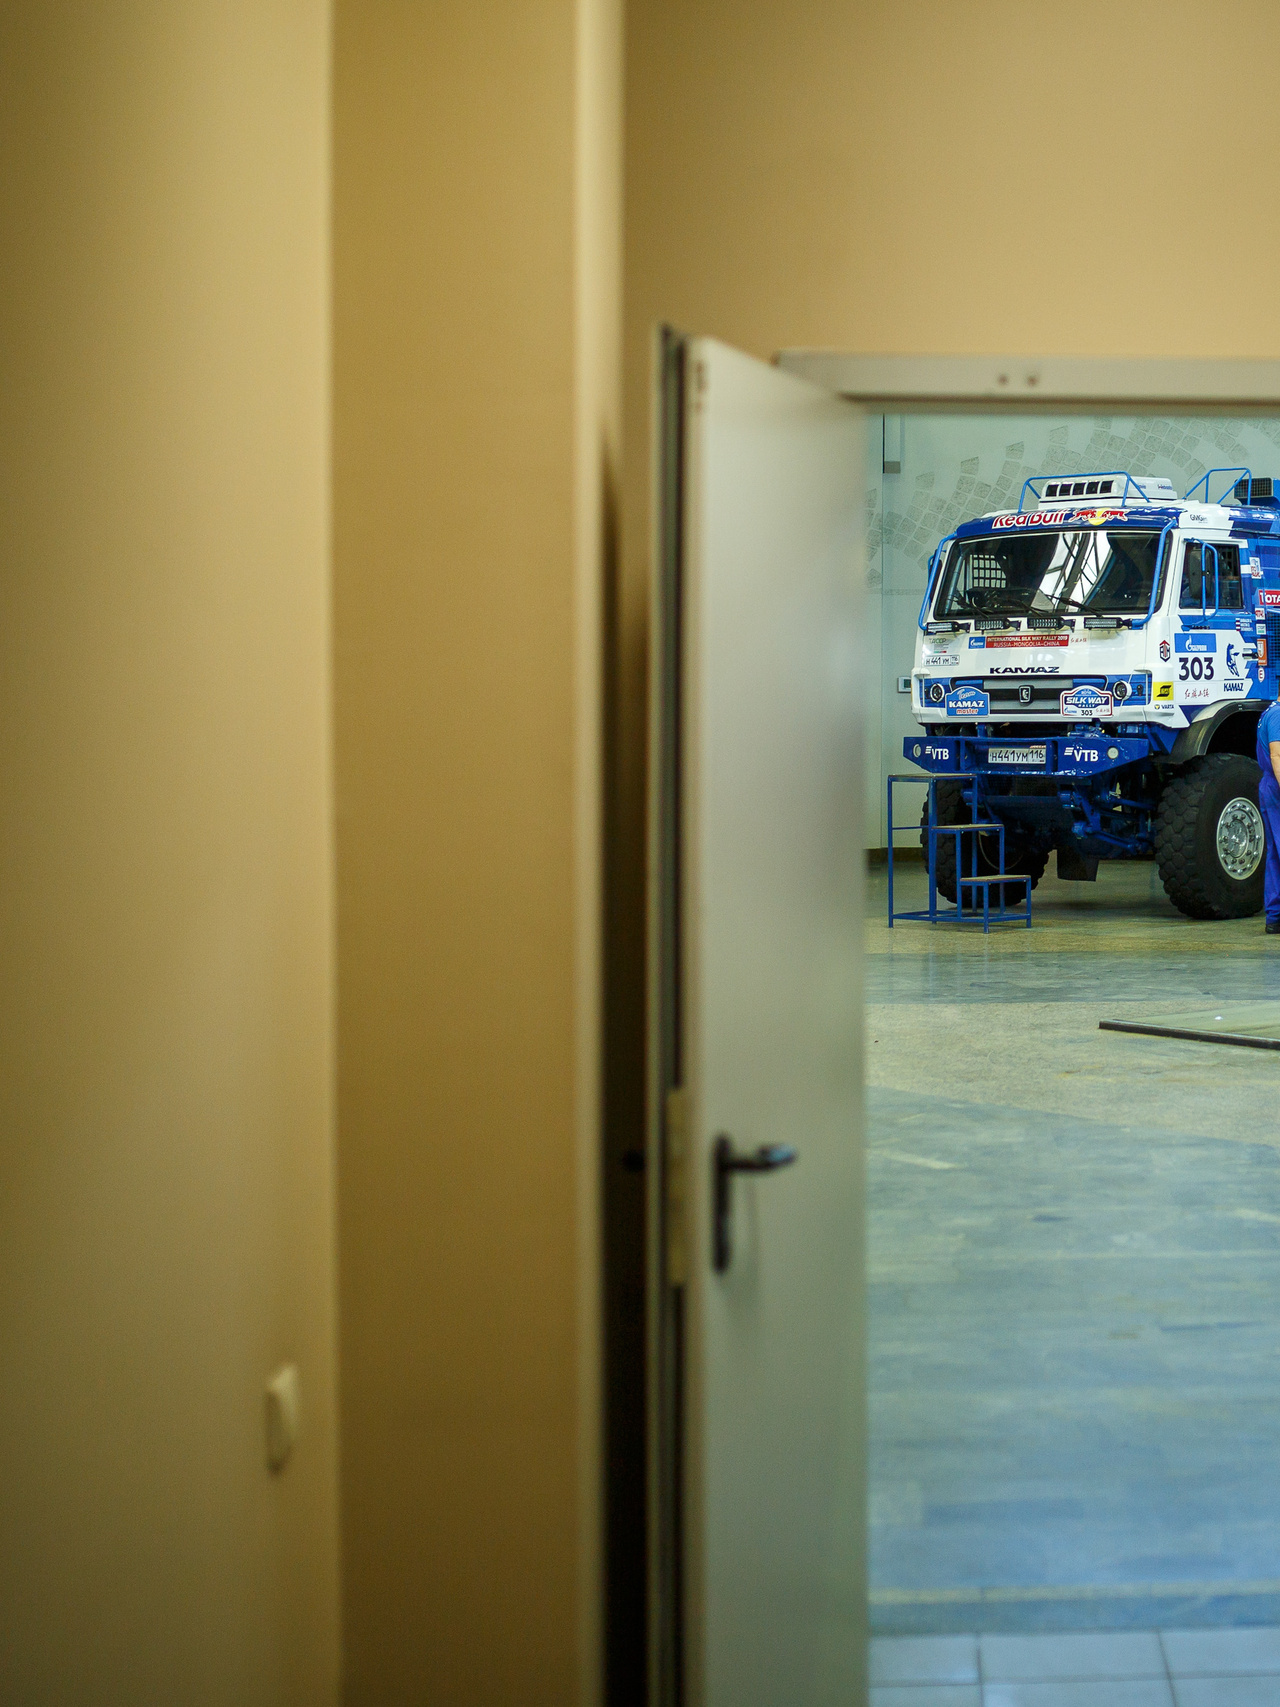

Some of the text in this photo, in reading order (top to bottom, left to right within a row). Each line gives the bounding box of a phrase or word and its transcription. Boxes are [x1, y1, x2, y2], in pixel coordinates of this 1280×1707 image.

[992, 510, 1066, 529] Red Bull
[1178, 656, 1214, 681] 303
[1223, 683, 1244, 692] KAMAZ
[949, 700, 985, 708] KAMAZ
[1066, 696, 1107, 704] SILK WAY
[931, 748, 950, 760] VTB
[1029, 749, 1044, 759] 116
[1074, 749, 1099, 762] VTB
